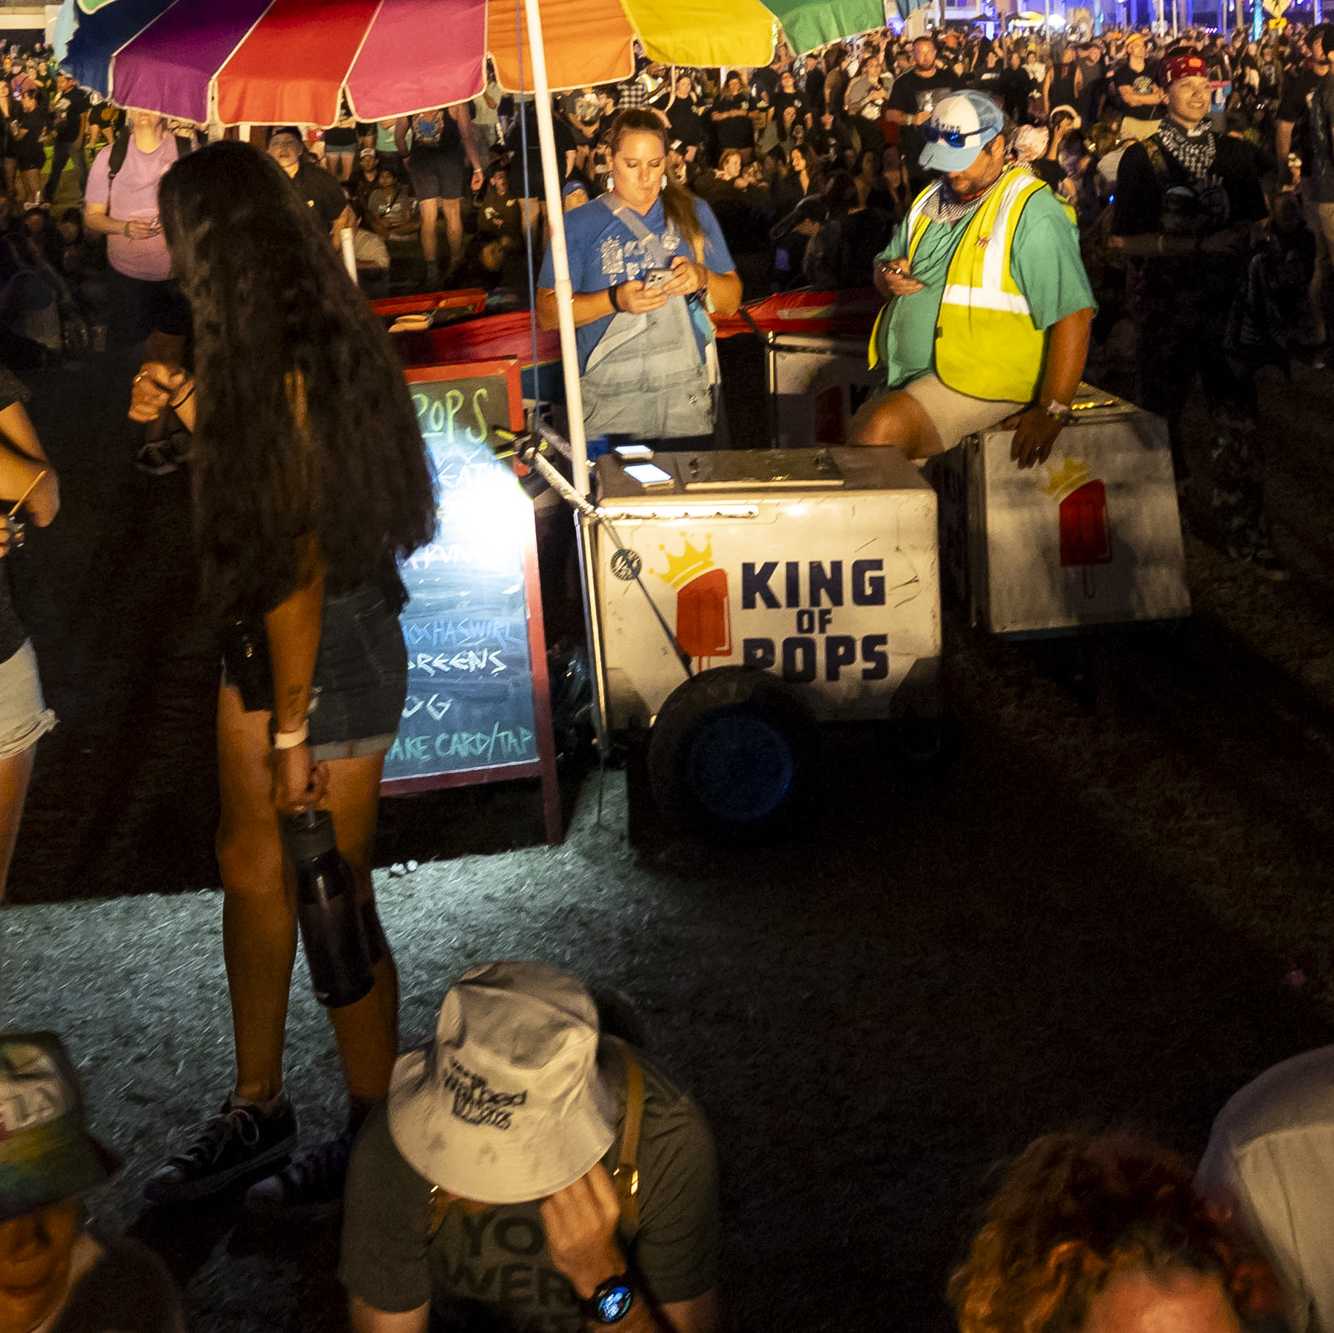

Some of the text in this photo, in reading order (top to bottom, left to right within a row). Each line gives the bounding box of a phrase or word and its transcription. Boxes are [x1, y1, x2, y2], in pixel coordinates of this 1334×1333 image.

[741, 558, 887, 609] KING
[796, 609, 833, 635] OF
[407, 648, 507, 677] REENS
[742, 633, 890, 683] POPS
[461, 1206, 547, 1258] YO
[443, 1262, 579, 1307] WER
